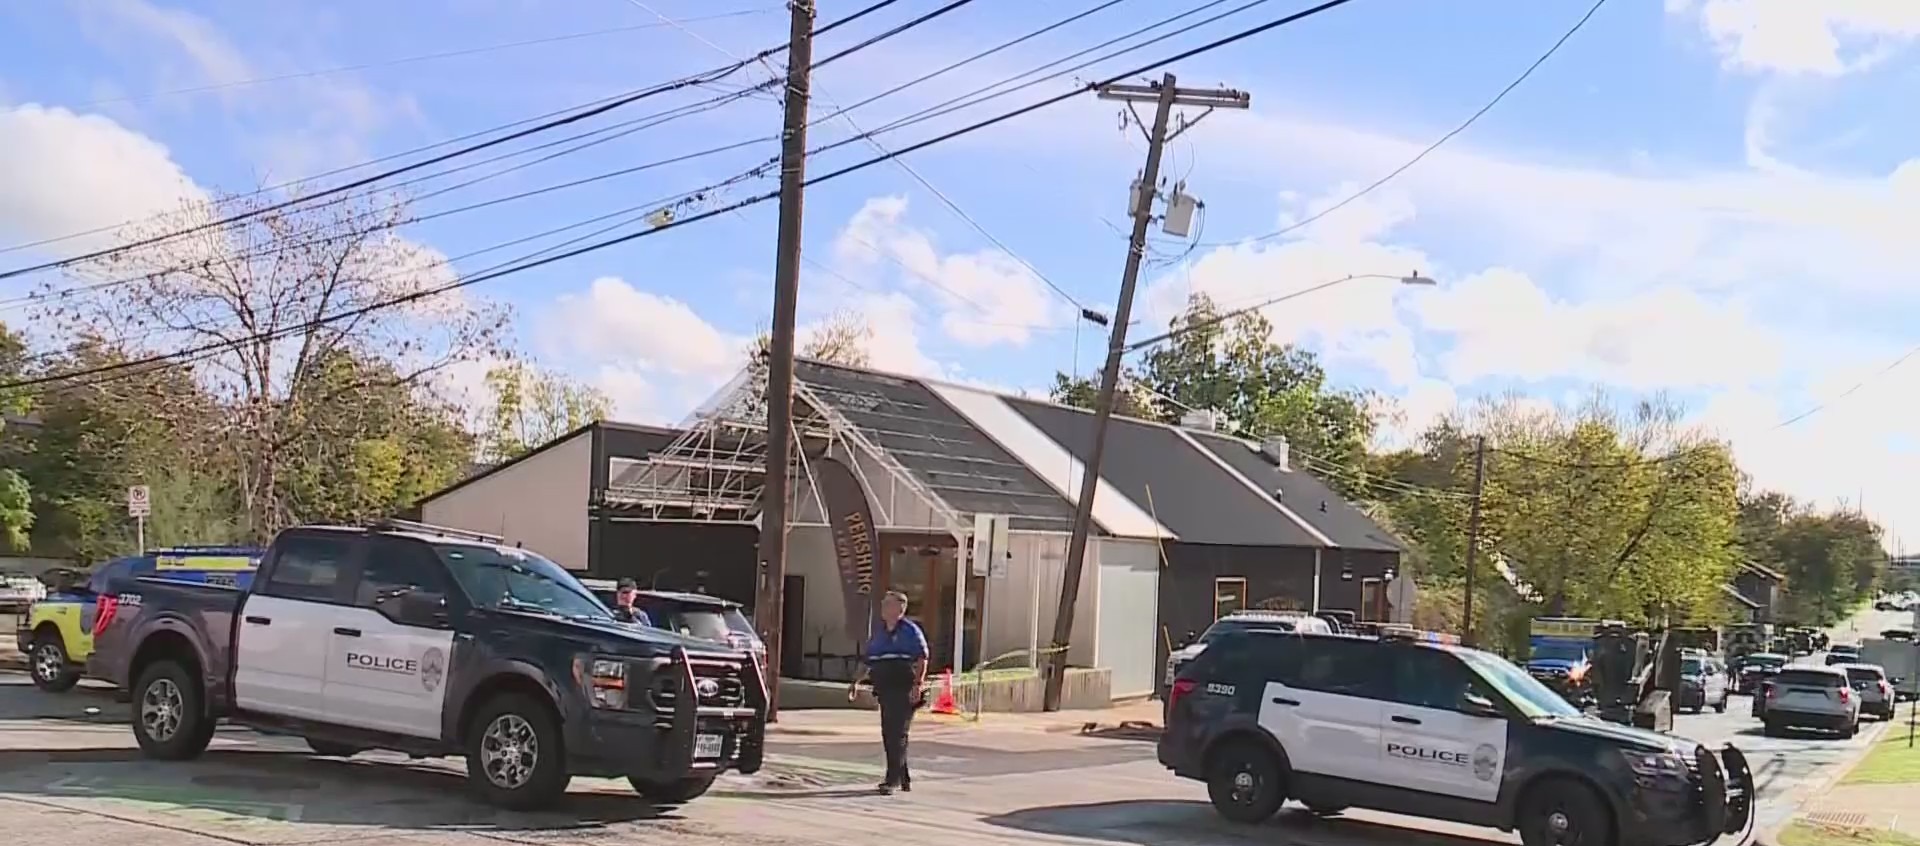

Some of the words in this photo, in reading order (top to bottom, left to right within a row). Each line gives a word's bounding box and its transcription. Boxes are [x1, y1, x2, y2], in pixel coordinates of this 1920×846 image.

[845, 511, 872, 594] PERSHING
[347, 653, 417, 671] POLICE
[1387, 743, 1469, 763] POLICE
